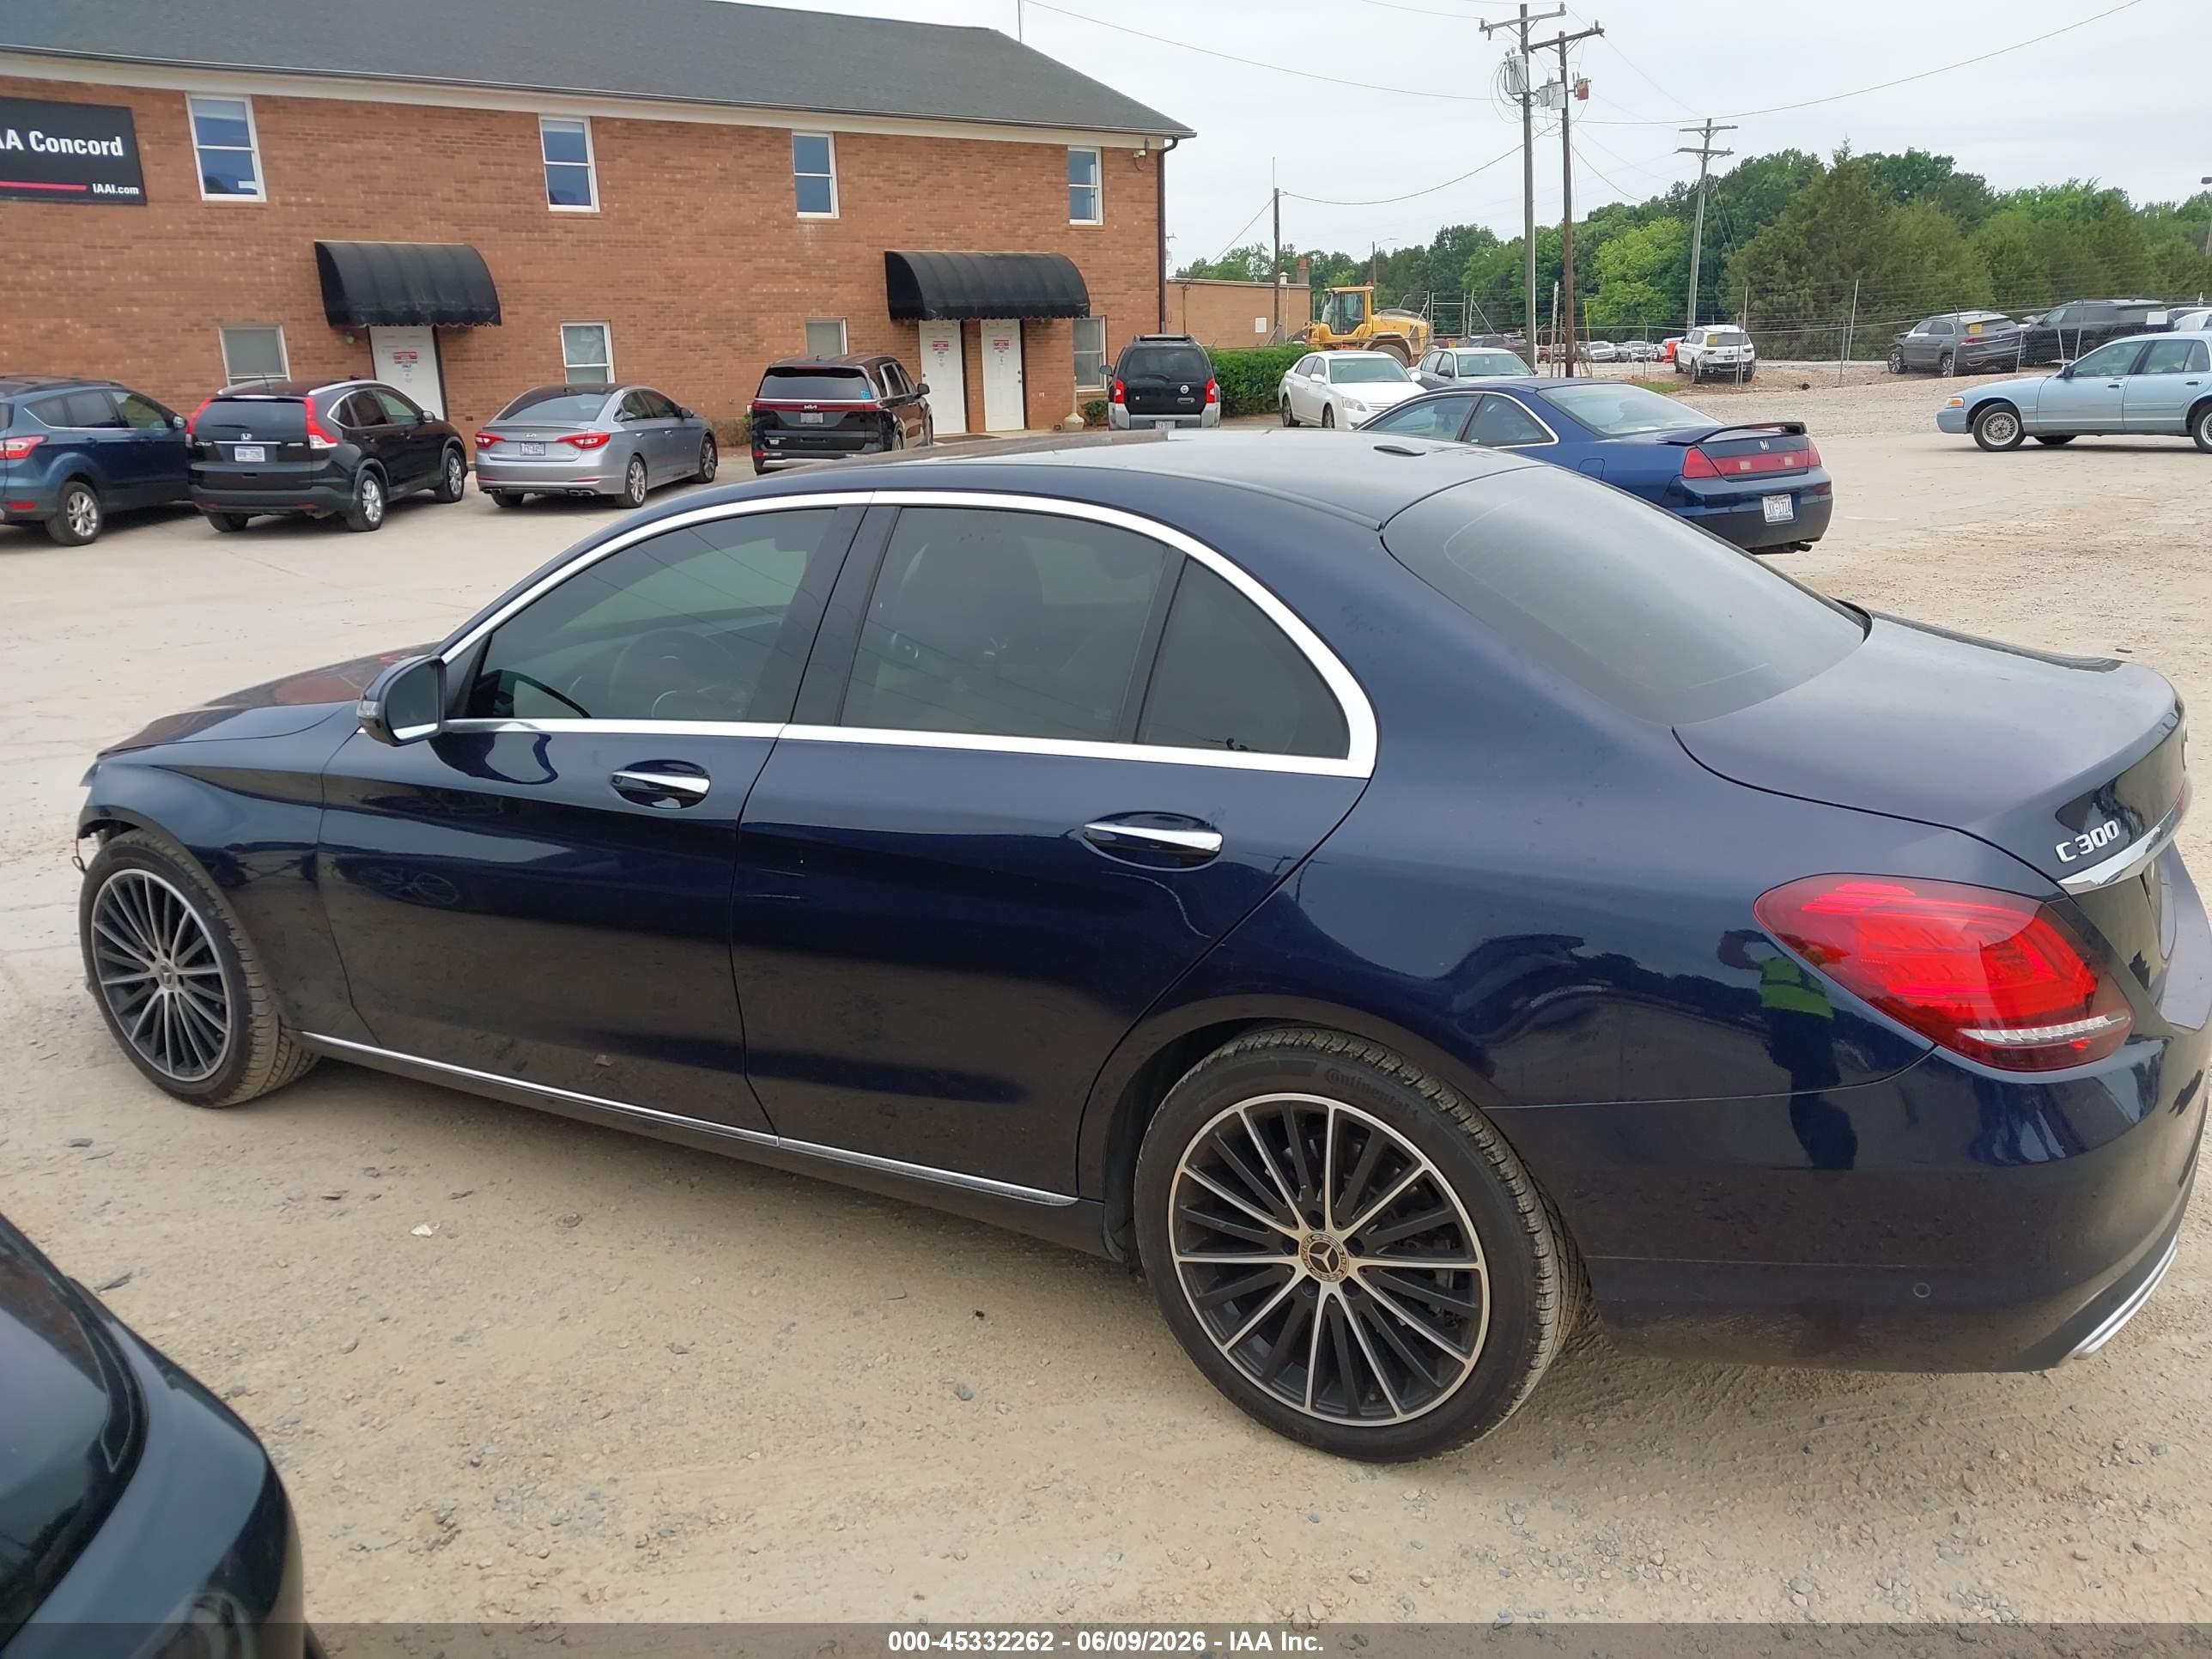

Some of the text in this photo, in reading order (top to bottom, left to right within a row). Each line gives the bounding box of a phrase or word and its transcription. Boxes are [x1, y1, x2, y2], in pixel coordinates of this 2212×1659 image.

[28, 130, 124, 156] Concord
[92, 183, 140, 195] IAAI.com
[2055, 820, 2120, 863] C 300
